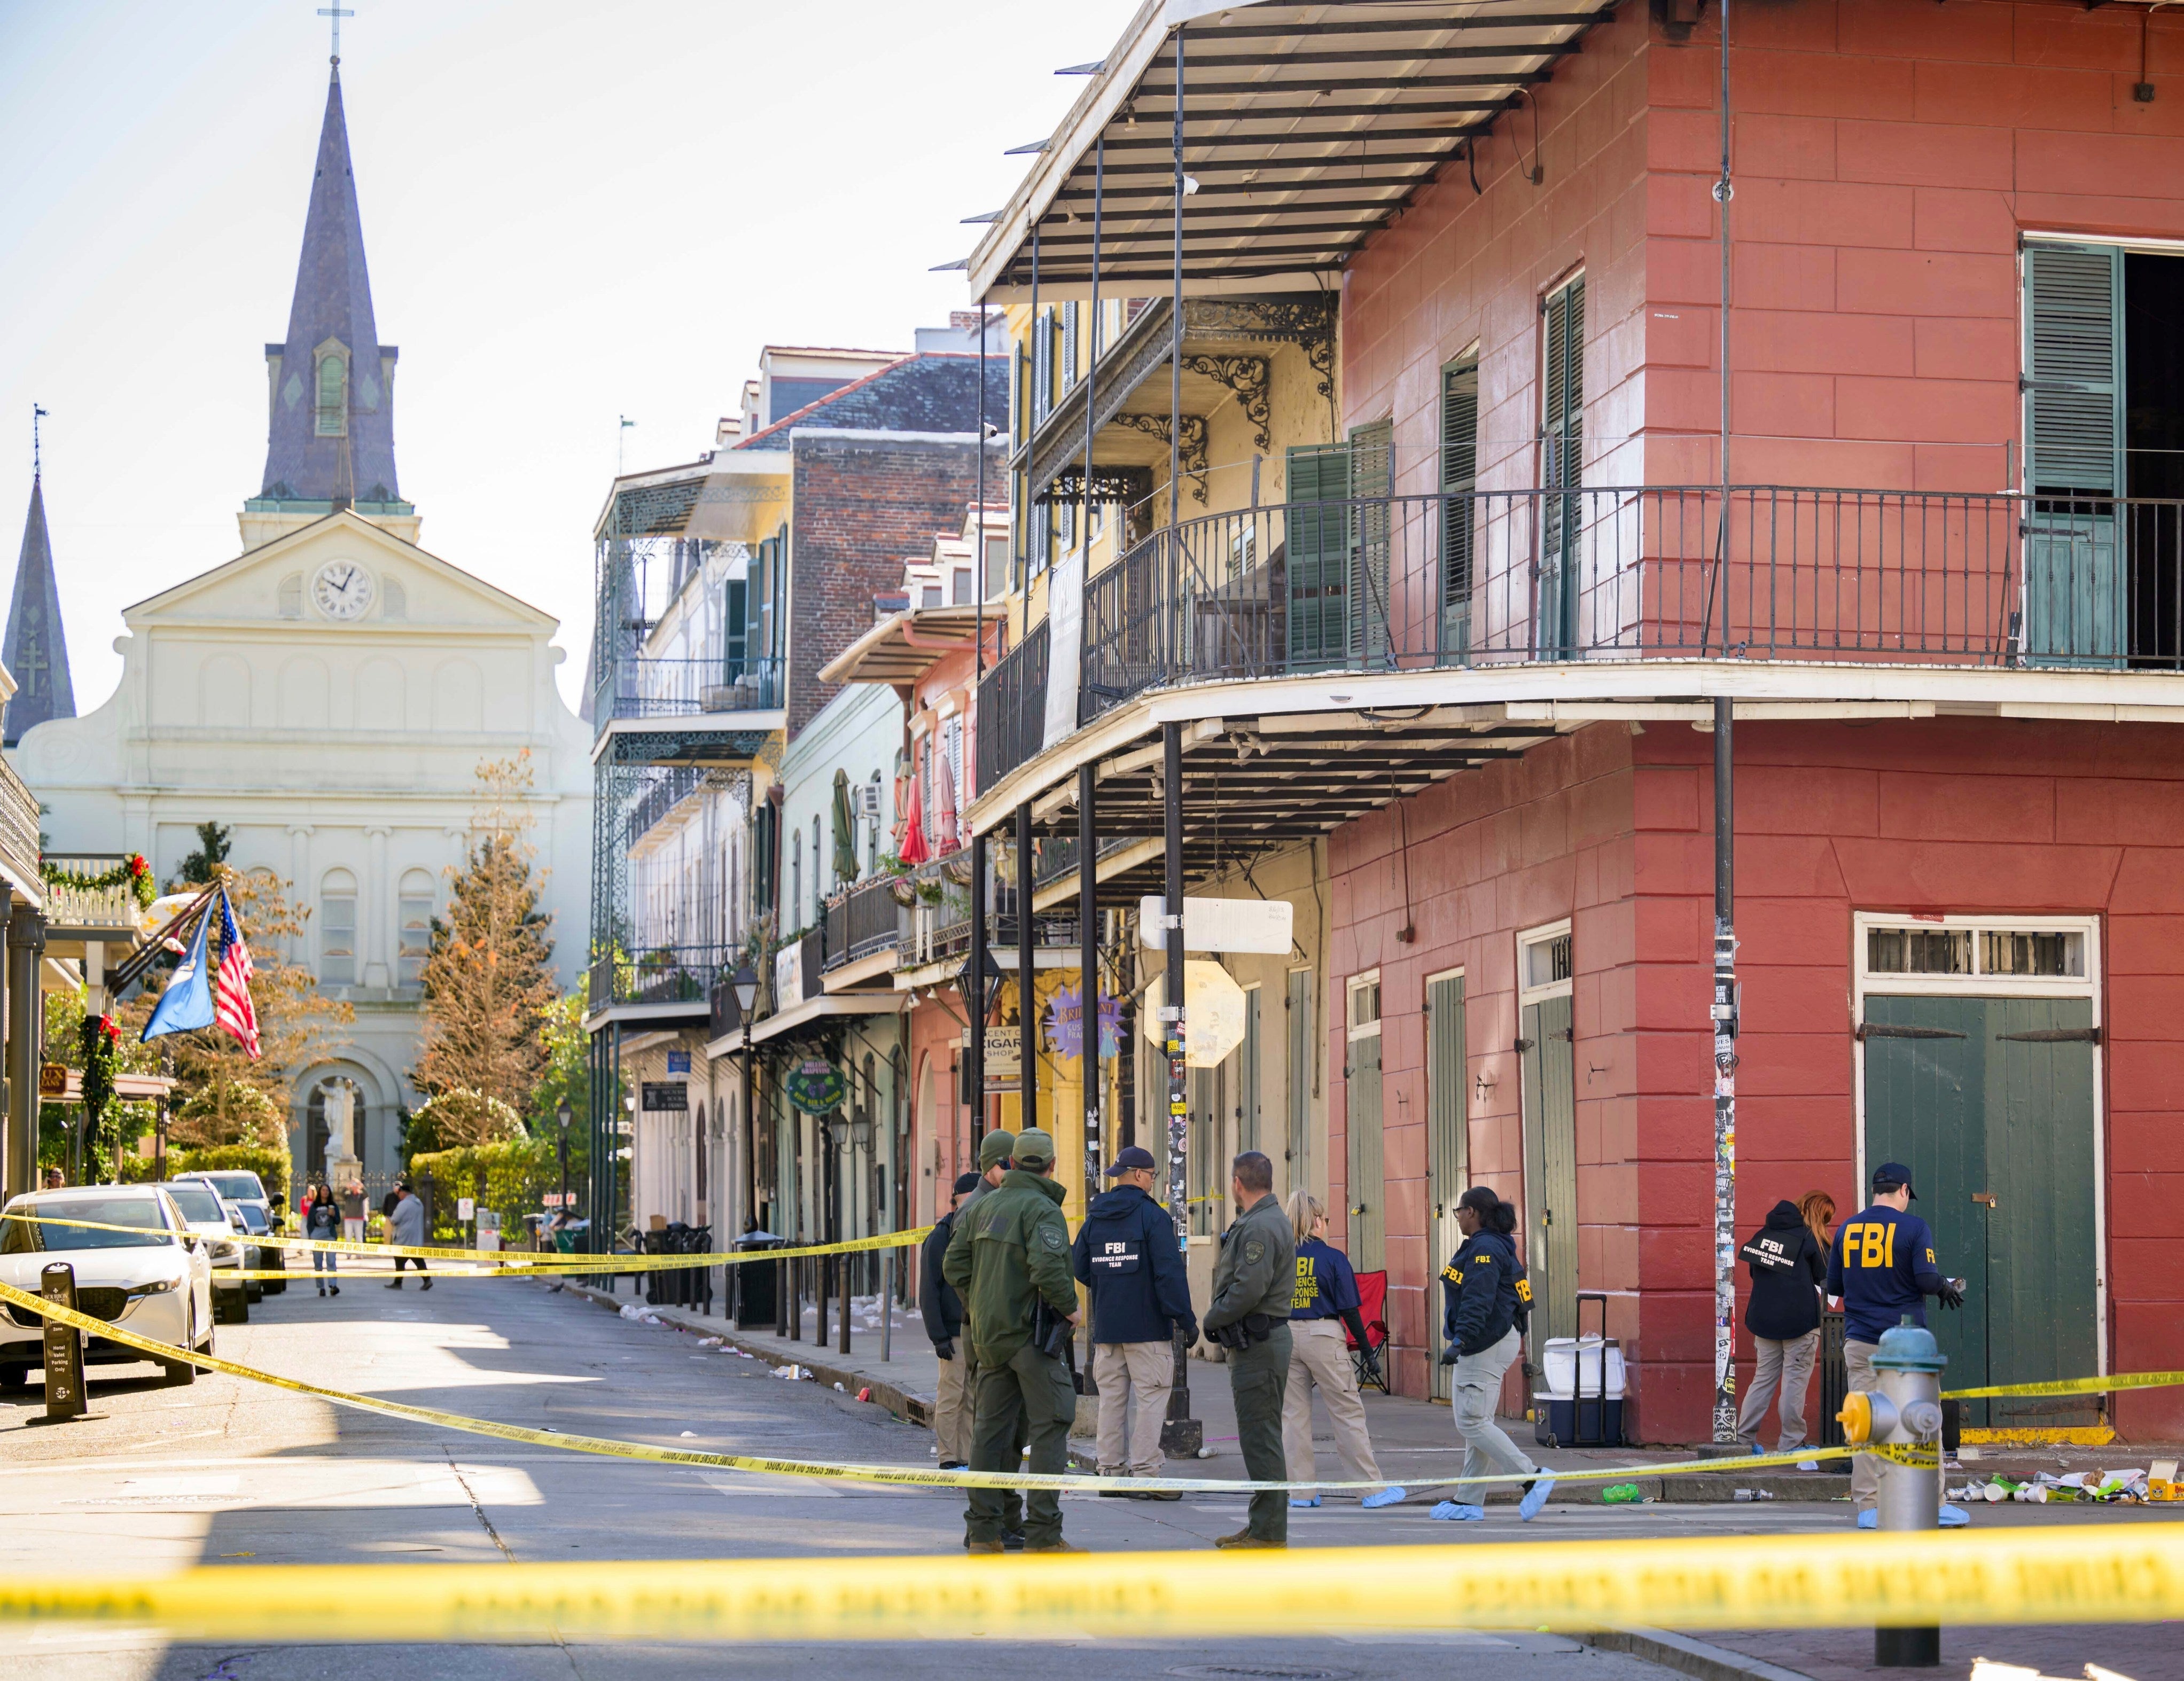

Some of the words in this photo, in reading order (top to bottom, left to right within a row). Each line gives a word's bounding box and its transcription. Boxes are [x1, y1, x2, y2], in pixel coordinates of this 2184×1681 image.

[1057, 1003, 1113, 1025] BRINT
[963, 1029, 1011, 1038] CCENT
[42, 1069, 63, 1080] UX
[1105, 1242, 1125, 1254] FBI
[1760, 1238, 1784, 1255] FBI
[1843, 1223, 1897, 1268] FBI
[1743, 1246, 1768, 1257] EVIDENCE
[1768, 1253, 1794, 1266] RESPONSE
[1925, 1248, 1936, 1264] FB
[1296, 1257, 1314, 1276] BI
[1760, 1257, 1774, 1266] TEAM
[1442, 1265, 1464, 1285] FBI
[1296, 1276, 1316, 1287] DENCE
[1293, 1287, 1319, 1297] PONSE
[1515, 1279, 1533, 1303] FB
[1290, 1297, 1311, 1309] TEAM
[661, 1452, 680, 1460] CROSS
[679, 1453, 691, 1461] NOT
[691, 1454, 700, 1462] DO
[700, 1455, 719, 1464] SCENE
[718, 1456, 738, 1466] CRIME
[765, 1461, 784, 1471] CROSS
[784, 1463, 796, 1472] NOT
[797, 1464, 805, 1472] DO
[806, 1465, 823, 1474] SCENE
